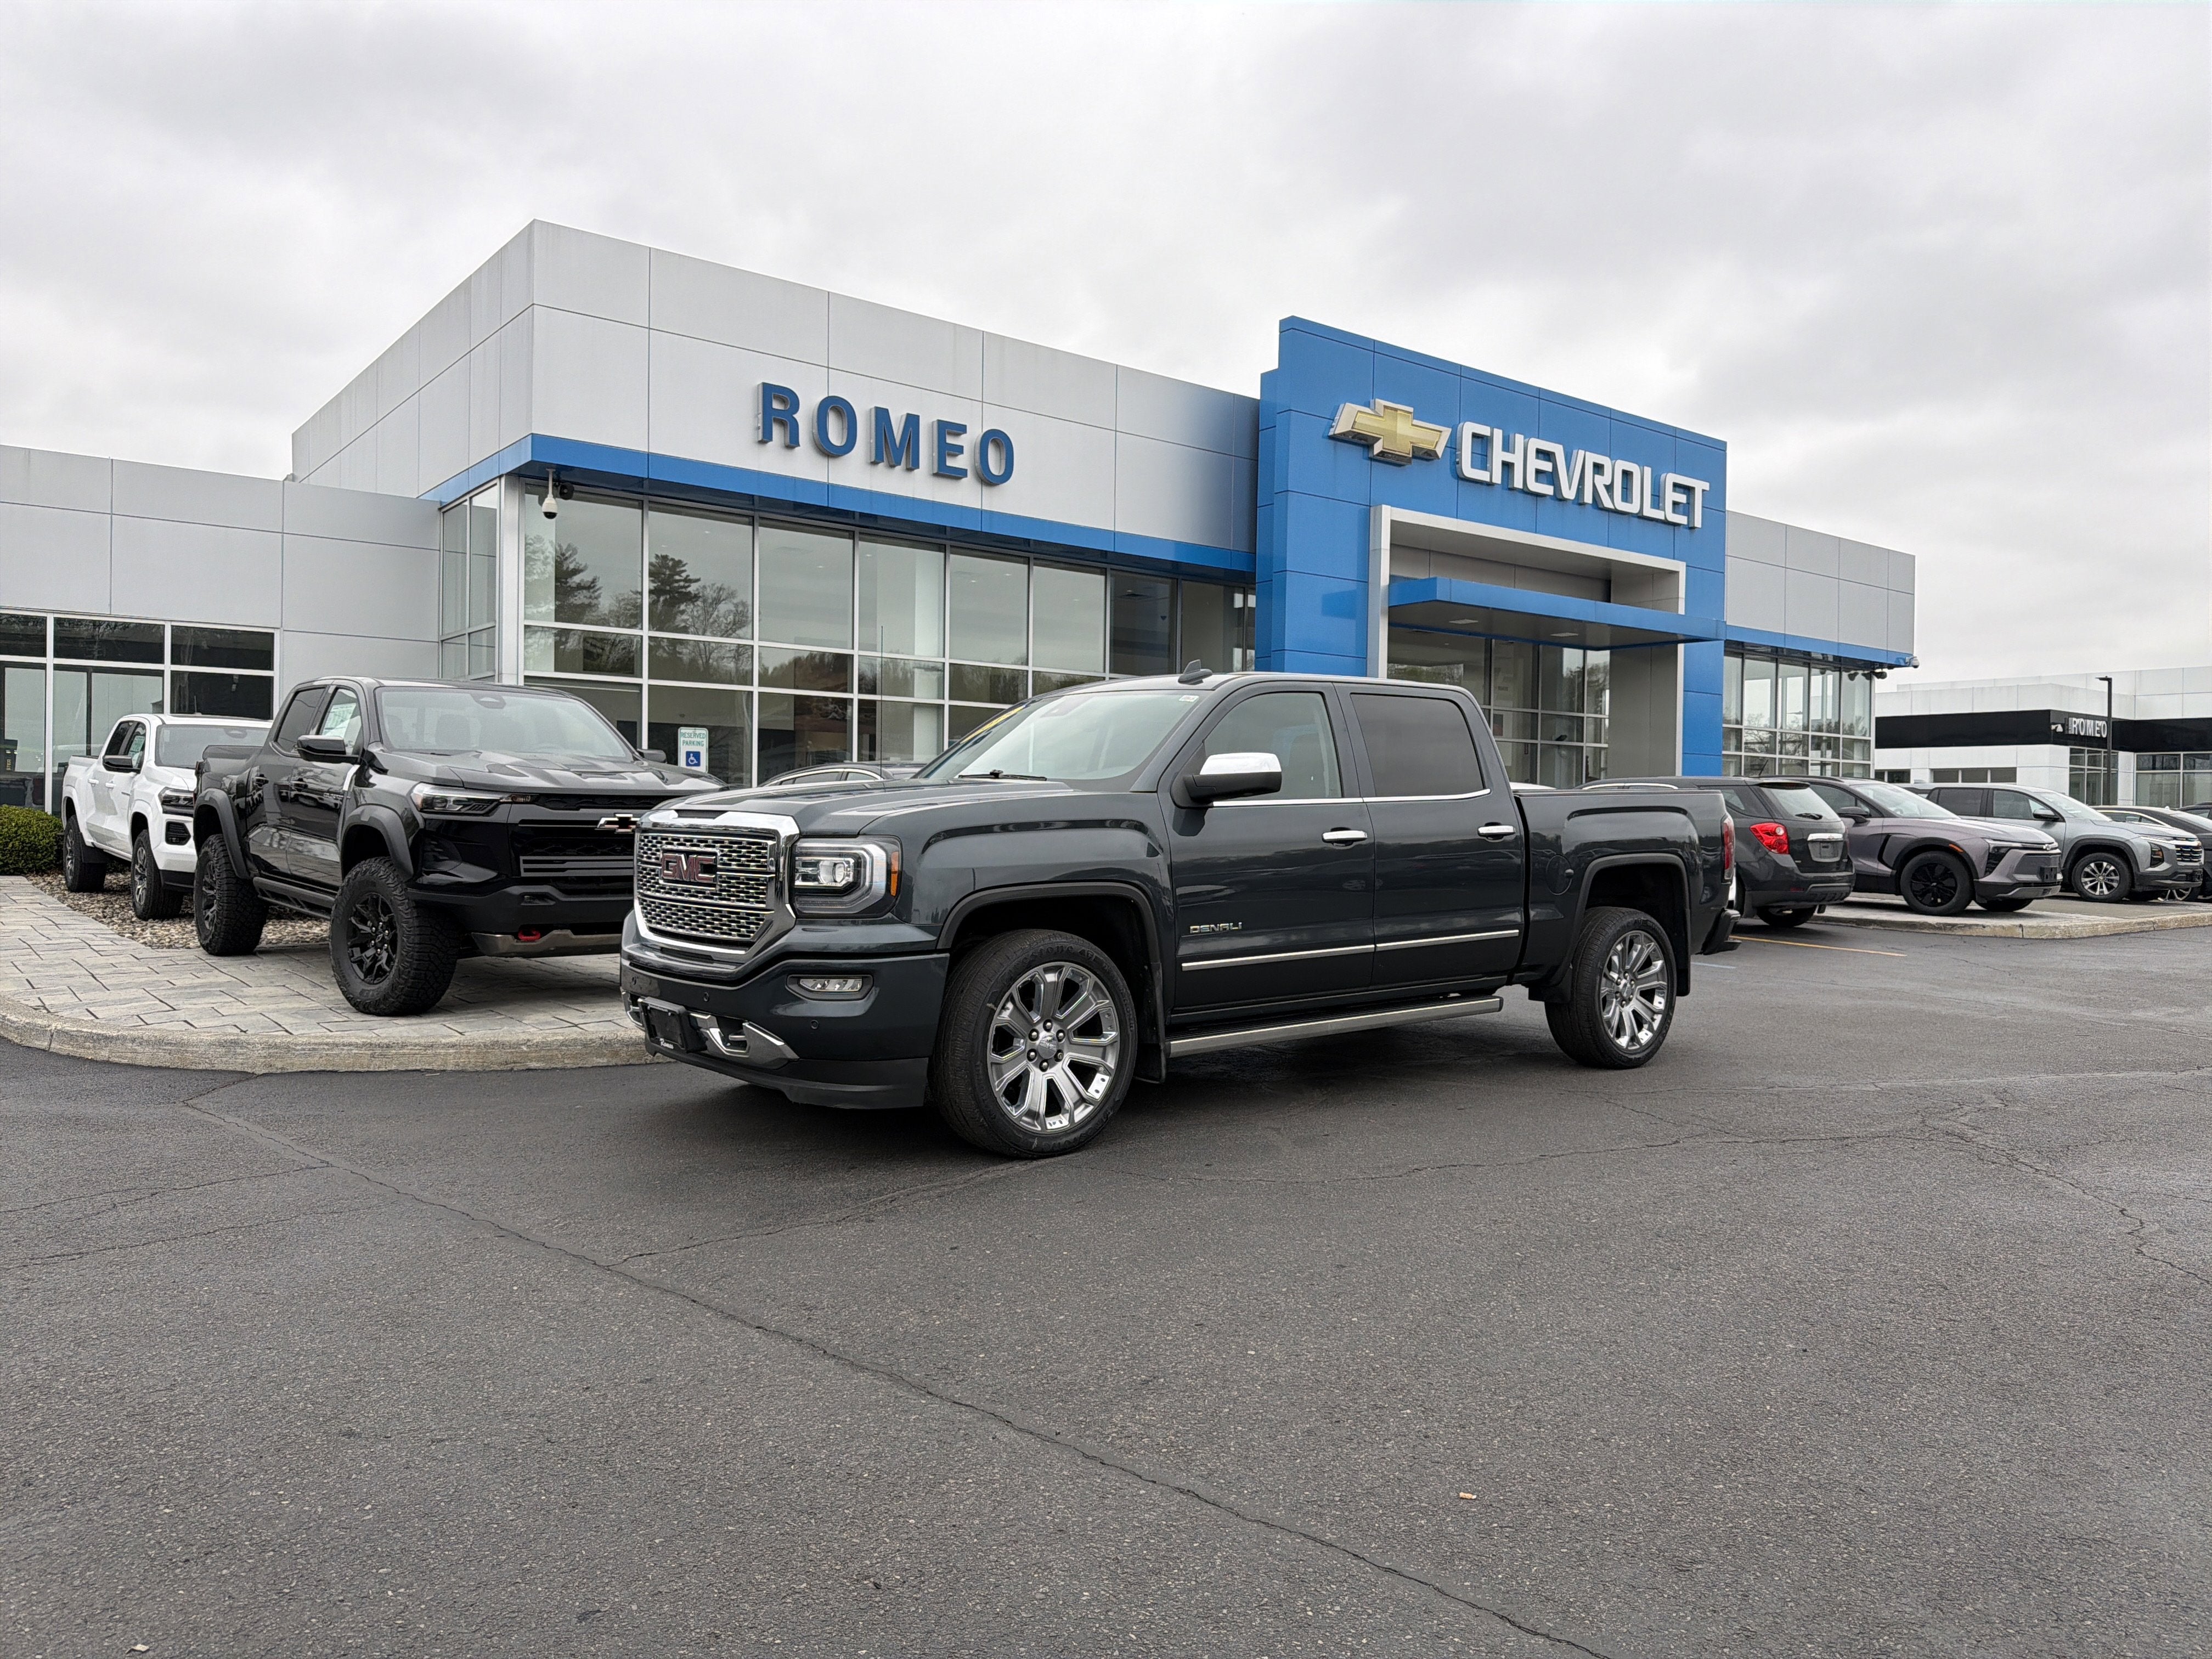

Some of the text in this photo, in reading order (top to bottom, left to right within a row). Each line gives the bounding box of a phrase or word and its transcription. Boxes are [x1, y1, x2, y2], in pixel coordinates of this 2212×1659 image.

[758, 382, 1014, 486] ROMEO
[1459, 421, 1710, 528] CHEVROLET
[2069, 718, 2107, 738] ROMEO
[662, 853, 716, 883] GMC
[1189, 922, 1242, 934] DENALI
